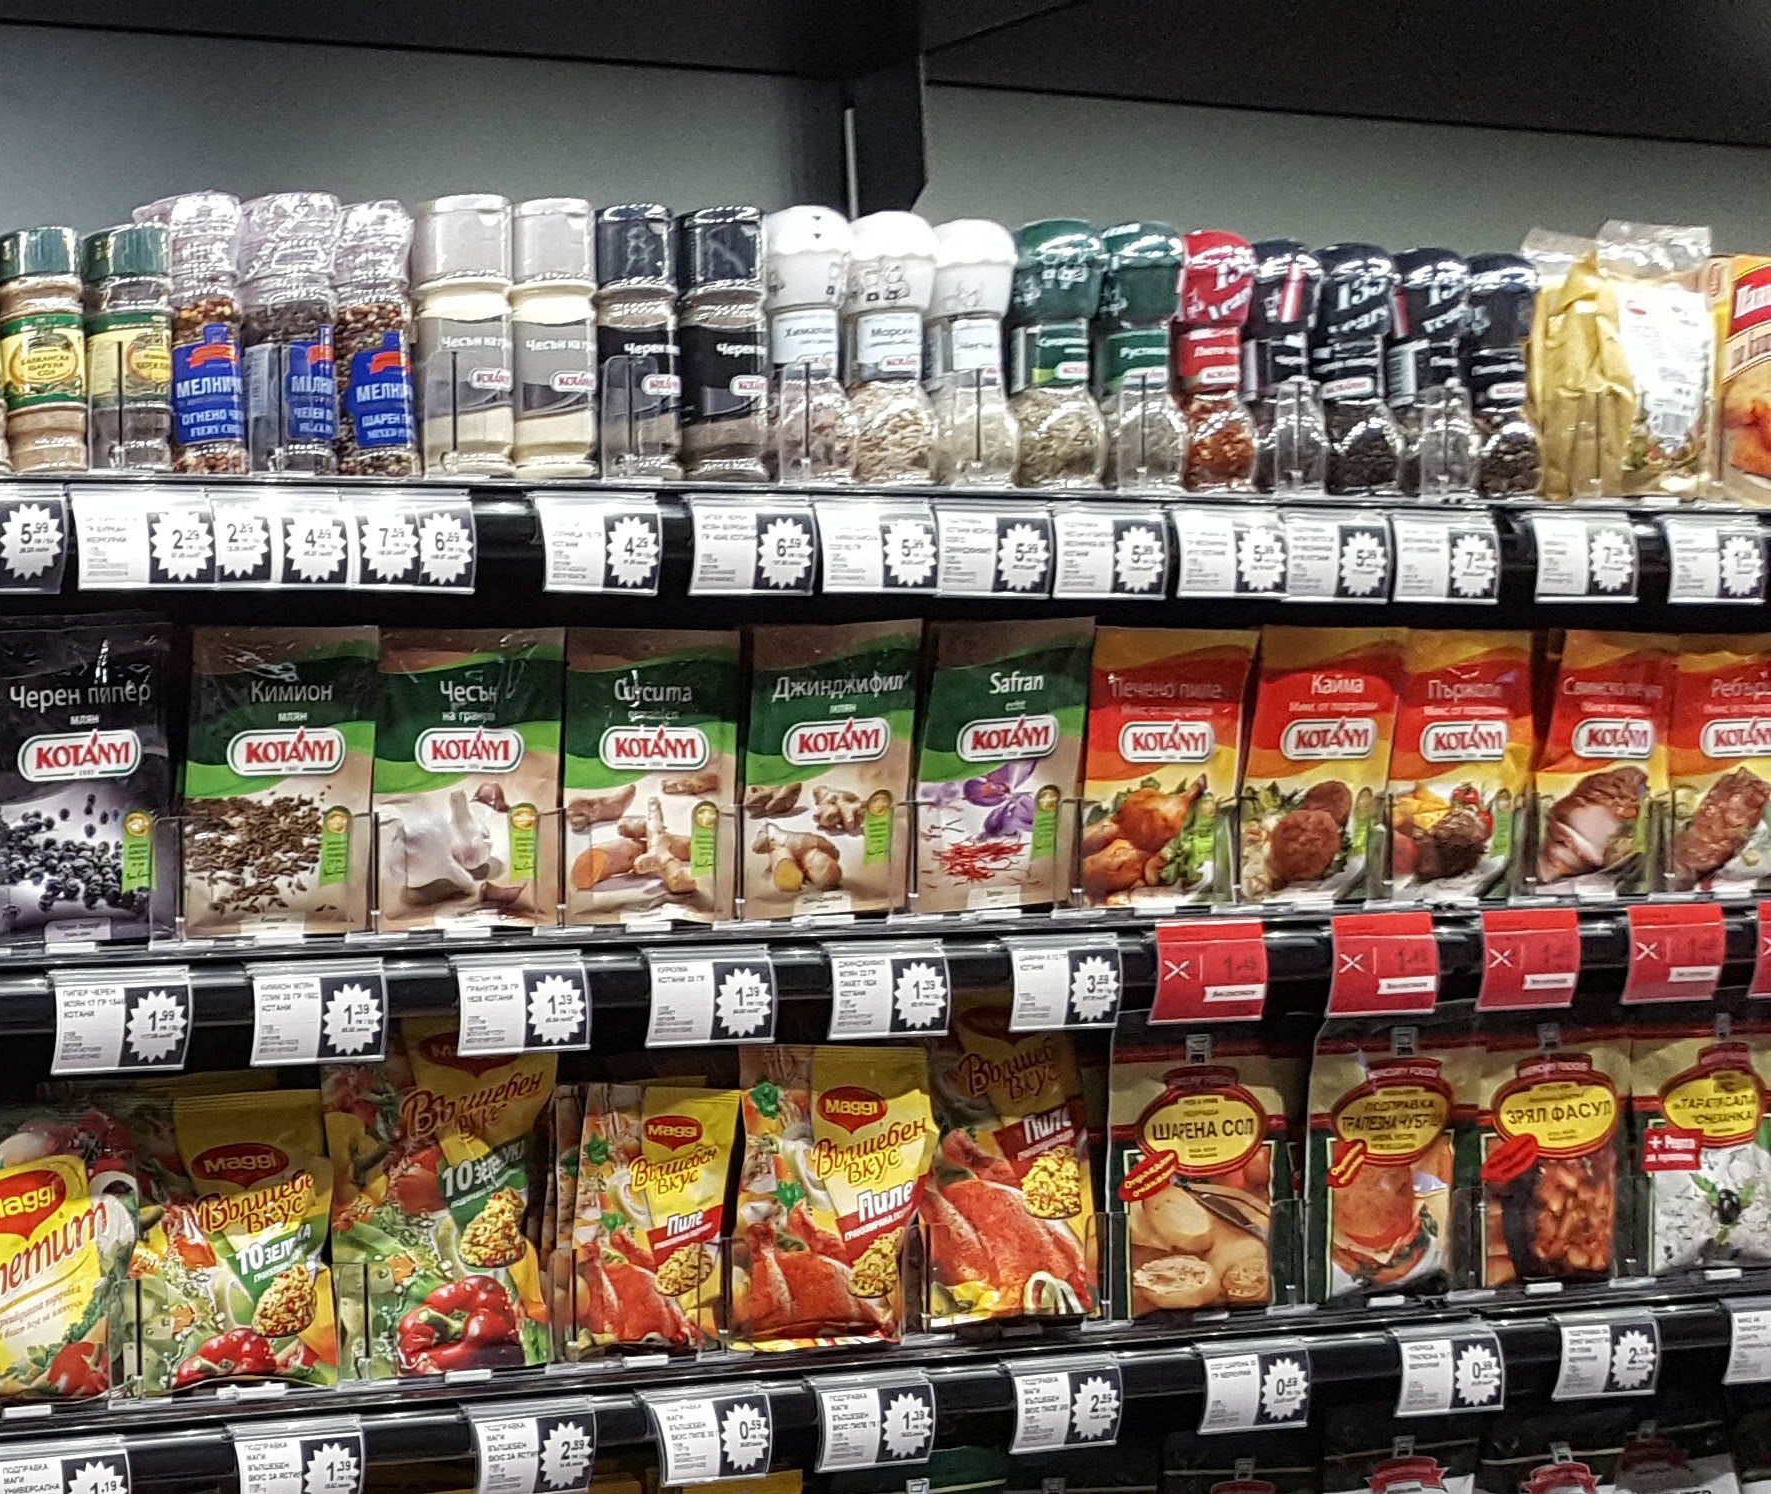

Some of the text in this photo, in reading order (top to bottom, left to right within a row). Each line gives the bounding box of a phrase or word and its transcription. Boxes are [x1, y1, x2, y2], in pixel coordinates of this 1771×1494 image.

[251, 681, 333, 702] Кимион
[1151, 1116, 1255, 1140] ШАРЕНА СОЛ
